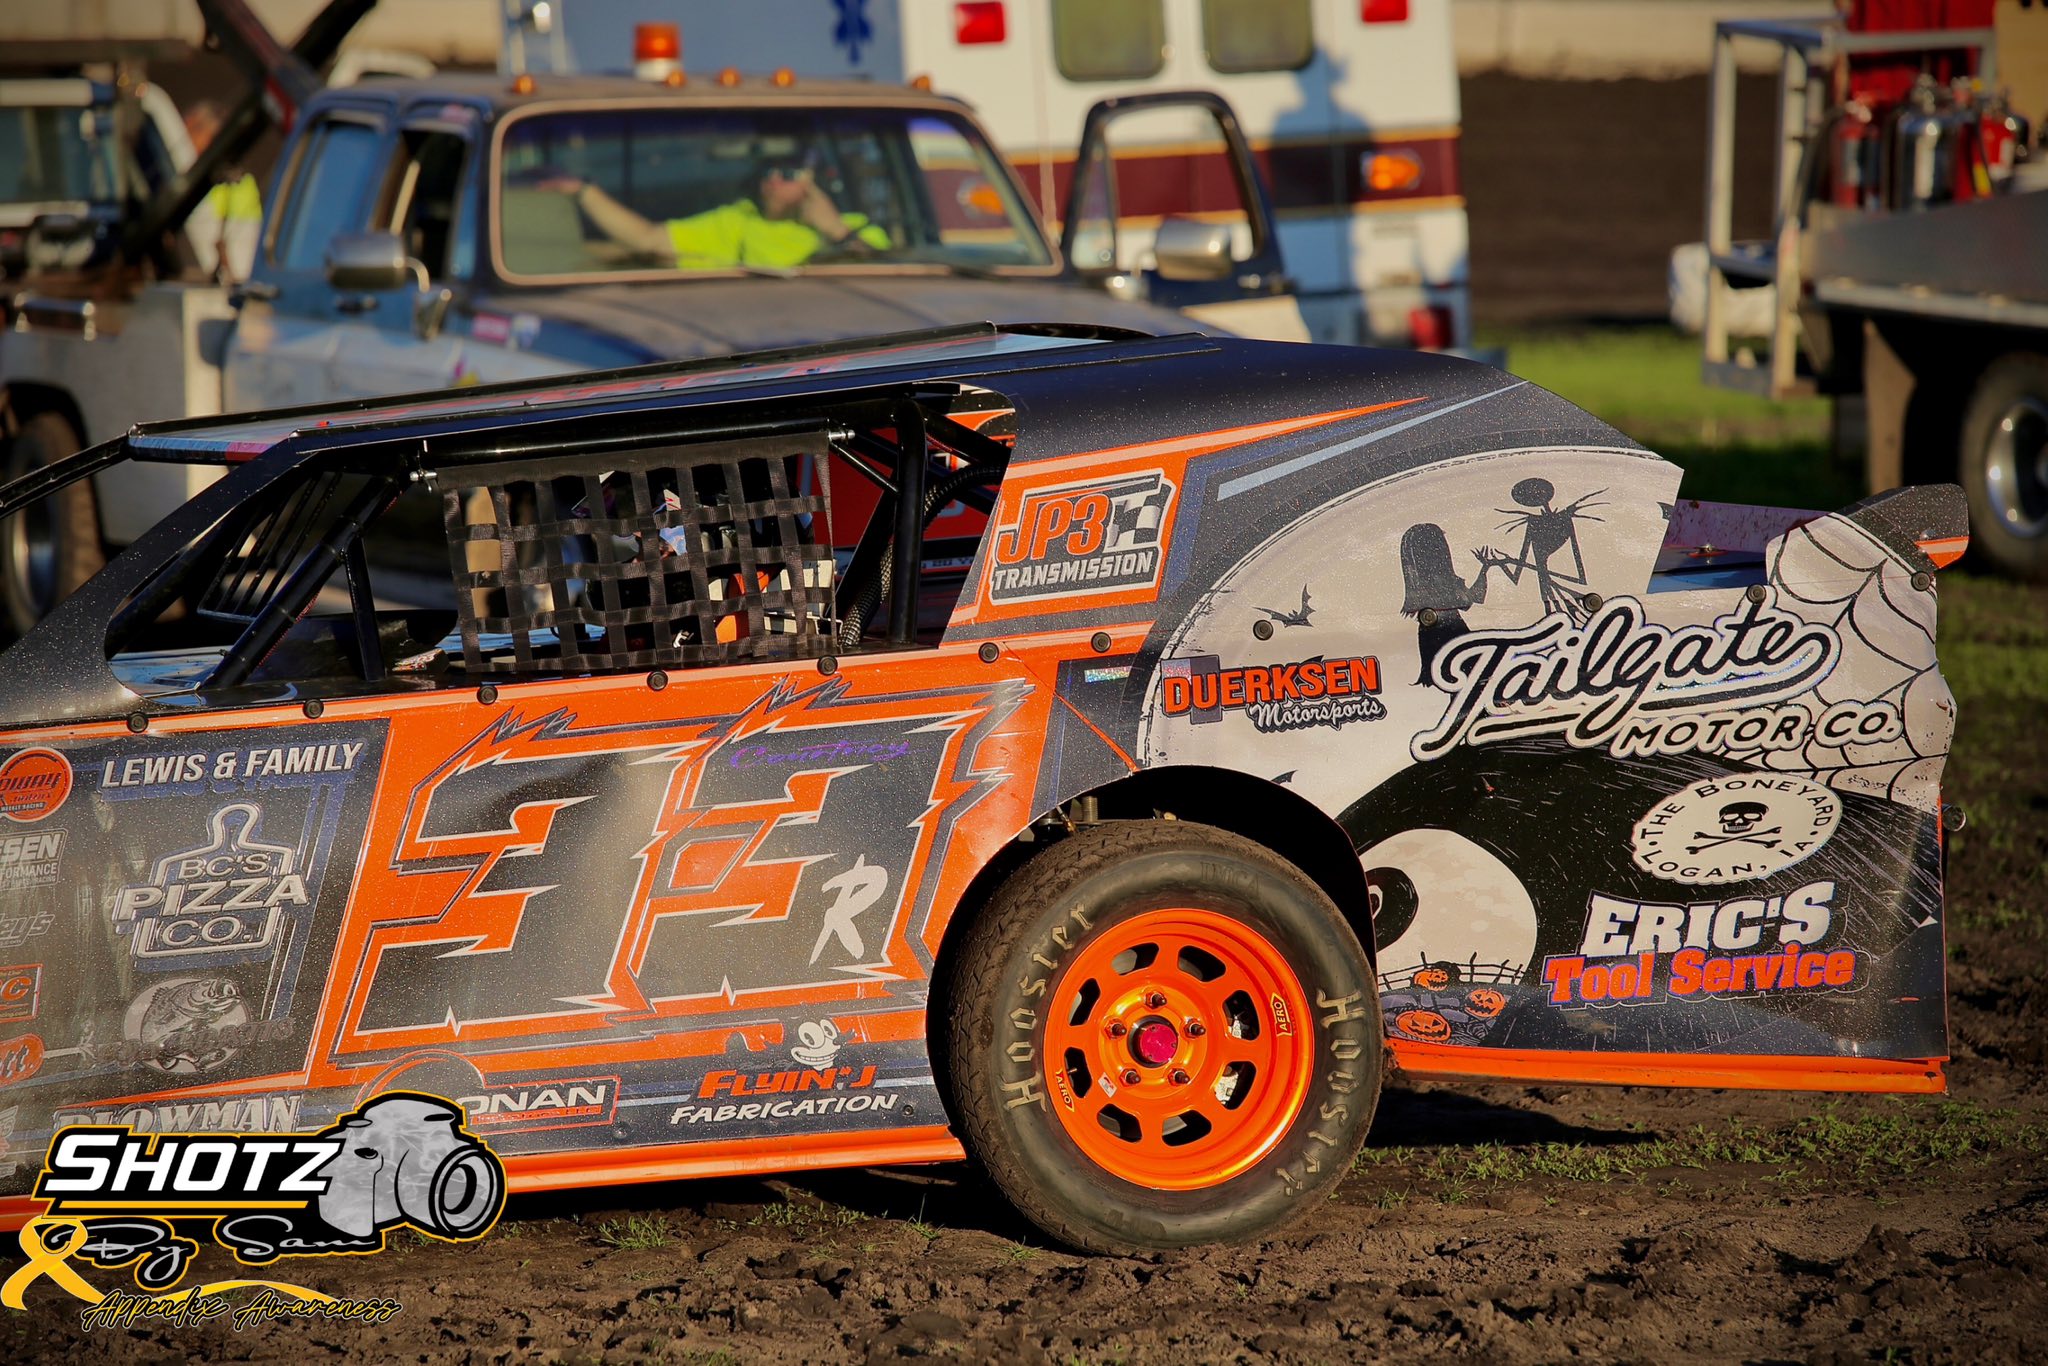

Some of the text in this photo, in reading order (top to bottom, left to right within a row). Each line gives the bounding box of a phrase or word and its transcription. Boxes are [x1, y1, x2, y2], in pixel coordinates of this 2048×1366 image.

[996, 494, 1110, 565] JP3
[993, 551, 1153, 591] TRANSMISSION
[1164, 657, 1379, 714] DUERKSEN
[1412, 597, 1838, 757] Tailgate
[1252, 699, 1382, 728] Motorsports
[1615, 704, 1901, 756] MOTOR CO.
[101, 741, 364, 789] LEWIS & FAMILY
[1641, 777, 1832, 840] THE BONEYARD
[0, 833, 61, 864] SEN
[178, 853, 272, 880] BC'S
[1641, 849, 1768, 879] LOGAN,
[117, 874, 309, 922] PIZZA
[1581, 881, 1837, 956] ERIC'S
[161, 916, 254, 947] CO.
[1548, 943, 1855, 1004] Tool Service
[1000, 902, 1094, 1113] Hoosier
[1273, 1001, 1288, 1031] AERO
[669, 1093, 899, 1125] FABRICATION
[1056, 1076, 1071, 1104] AERO
